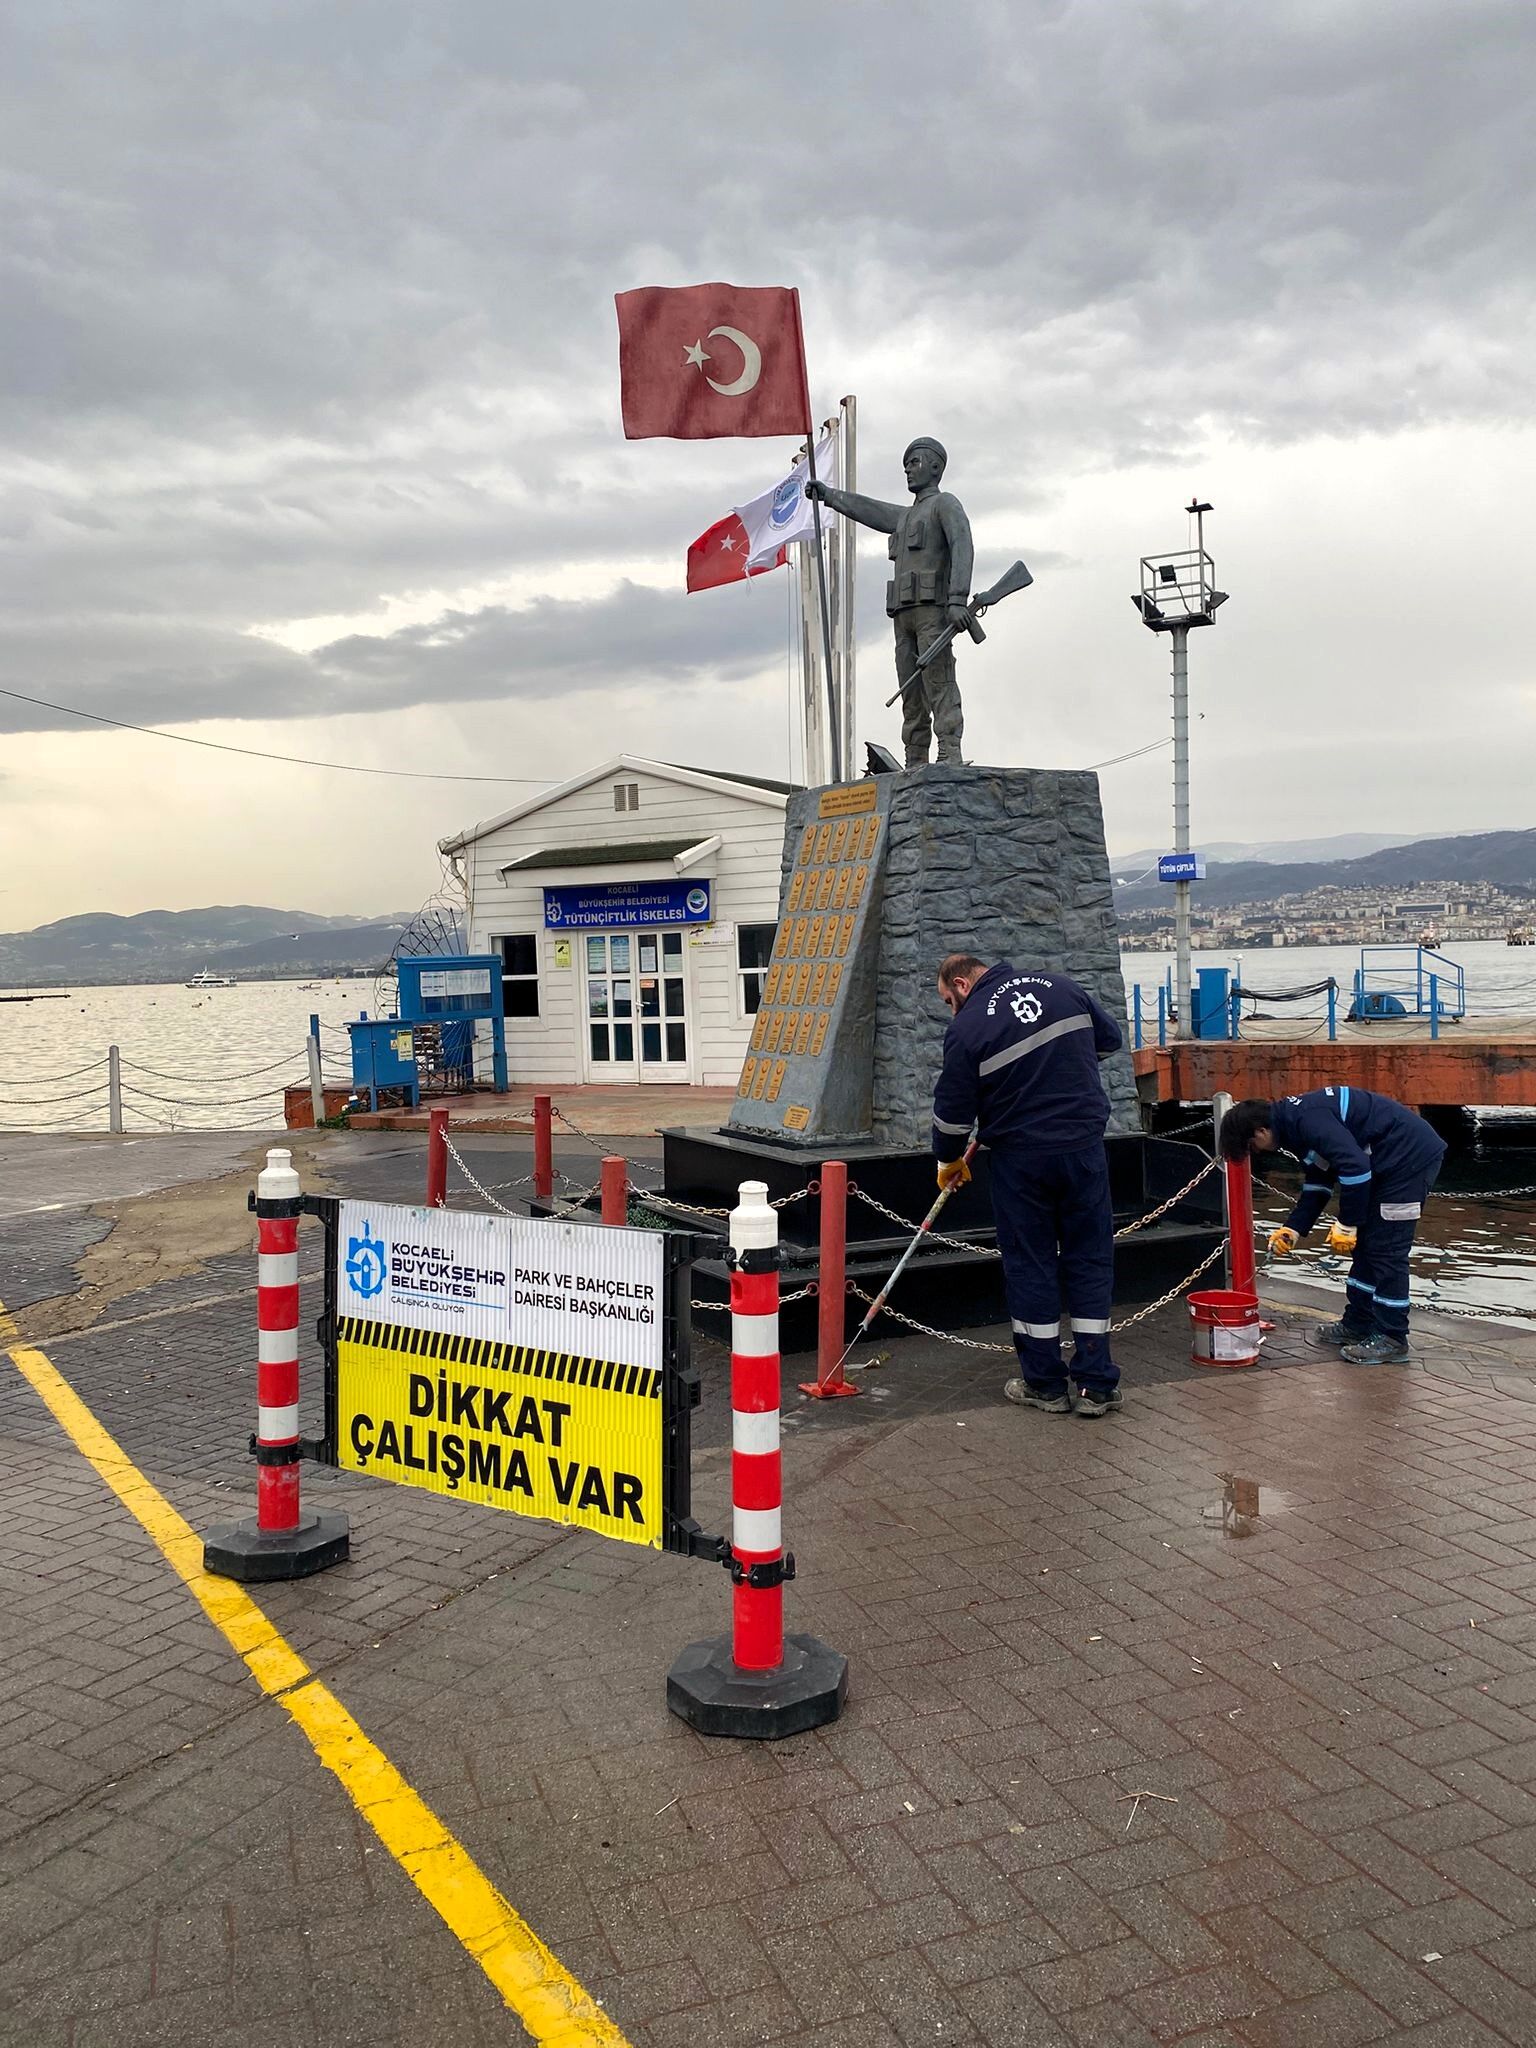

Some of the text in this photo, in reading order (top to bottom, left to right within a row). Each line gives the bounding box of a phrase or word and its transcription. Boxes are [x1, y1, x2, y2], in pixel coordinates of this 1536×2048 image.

[579, 895, 670, 908] BÜYÜKŞEHİR BELEDİYESİ
[607, 885, 639, 894] KOCAELİ
[564, 906, 686, 925] TÜTÜNÇİFTLİK İSKELESİ
[514, 1268, 654, 1301] PARK VE BAHÇELER
[431, 1303, 465, 1313] OLUYOR
[514, 1289, 654, 1324] DAİRESİ BAŞKANLIĞI
[409, 1368, 571, 1447] DİKKAT
[350, 1413, 645, 1524] ÇALIŞMA VAR
